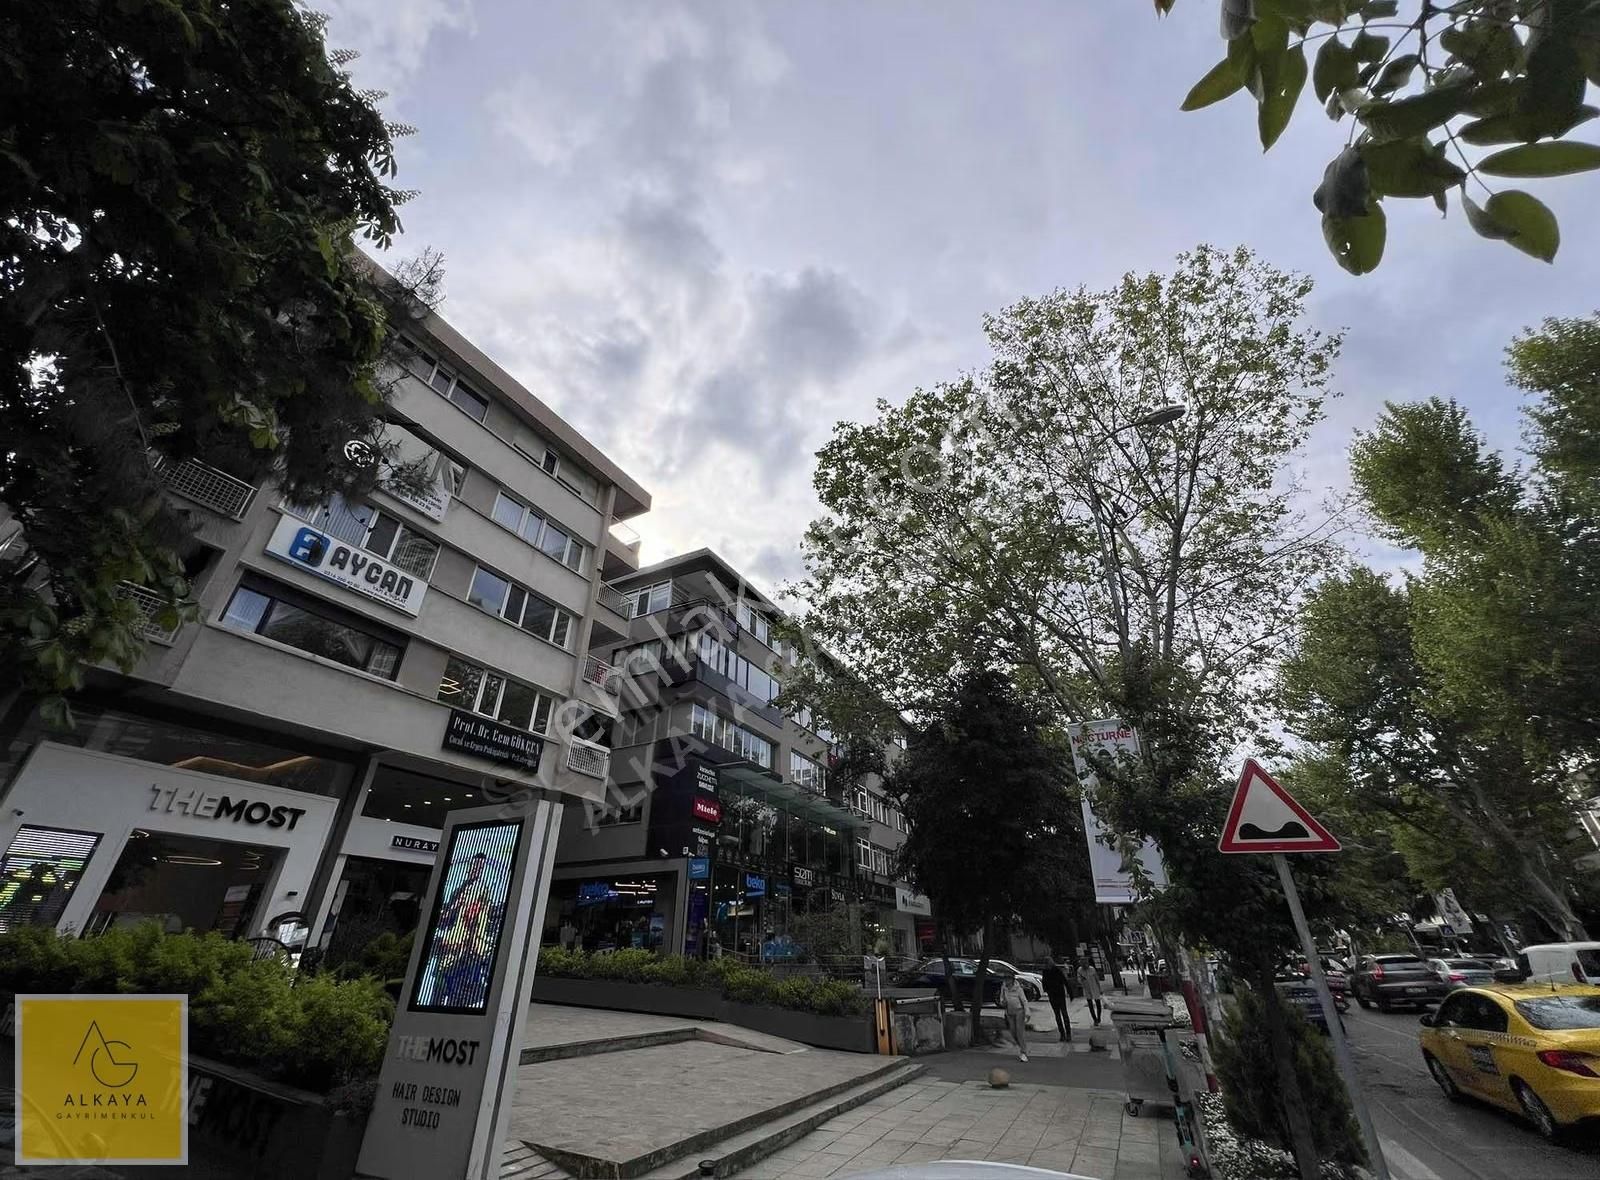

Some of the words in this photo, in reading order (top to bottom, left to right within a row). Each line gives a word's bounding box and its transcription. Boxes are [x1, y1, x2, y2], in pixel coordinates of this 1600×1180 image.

[696, 803, 719, 817] Miele
[395, 837, 437, 850] NURAY
[746, 873, 766, 890] beko
[391, 1080, 418, 1101] HAIR
[422, 1084, 461, 1107] DESIGN
[401, 1108, 440, 1130] STUDIO
